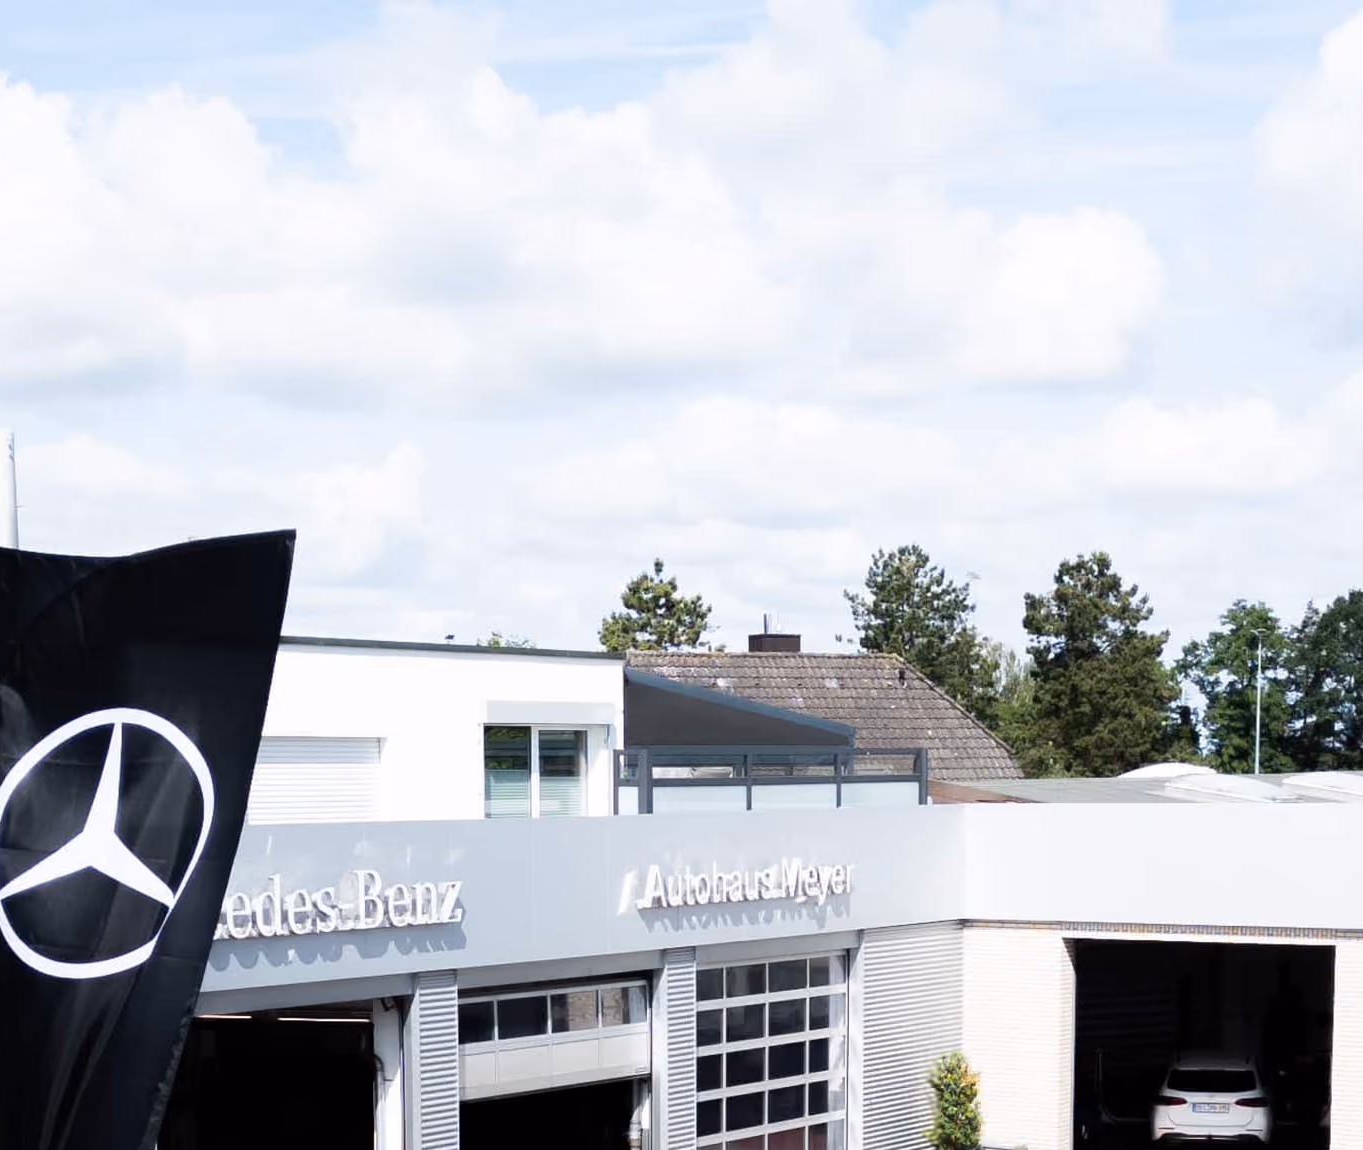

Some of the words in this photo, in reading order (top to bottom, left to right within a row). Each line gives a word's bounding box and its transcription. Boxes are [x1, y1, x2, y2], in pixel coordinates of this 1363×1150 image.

[213, 869, 463, 940] edes-Benz
[639, 860, 778, 909] Autohaus
[781, 856, 855, 906] Meyer
